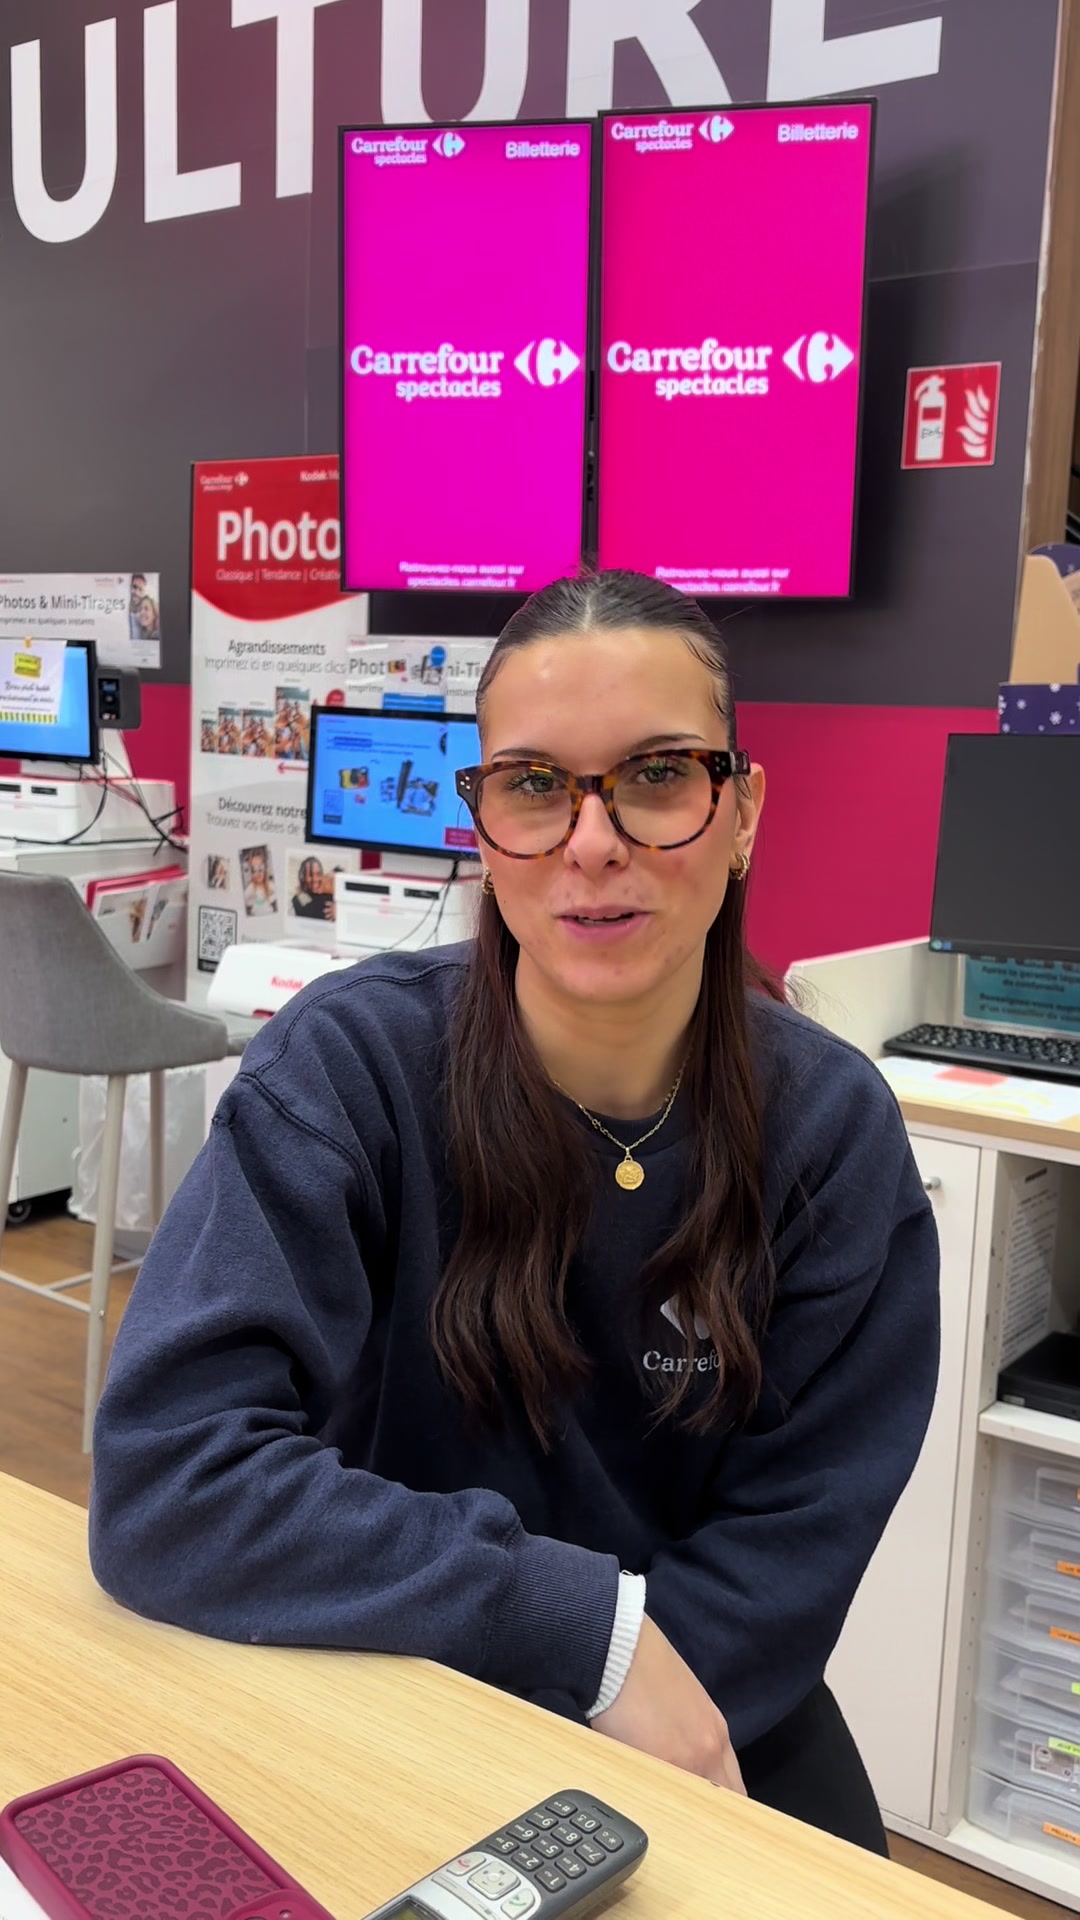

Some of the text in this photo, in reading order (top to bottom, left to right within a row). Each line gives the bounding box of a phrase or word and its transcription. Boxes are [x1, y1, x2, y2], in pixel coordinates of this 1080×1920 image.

[611, 120, 694, 140] Carrefour
[777, 122, 859, 143] Billetterie
[351, 136, 428, 154] Carrefour
[505, 140, 581, 159] Billetterie
[350, 341, 505, 376] Carrefour
[607, 336, 773, 373] Carrefour
[395, 375, 502, 403] spectacles
[655, 371, 769, 401] spectacles
[217, 506, 340, 562] Photo
[216, 568, 254, 583] Classique
[261, 568, 302, 581] Tendance
[51, 594, 126, 614] Mini-Tirages
[228, 640, 326, 657] Agrandissements
[204, 656, 248, 671] Imprimez
[278, 659, 321, 675] quelques
[218, 796, 273, 816] Découvrez
[206, 812, 240, 829] Trouvez
[243, 819, 257, 831] vos
[260, 820, 284, 834] idées
[541, 1816, 553, 1826] 9
[522, 1829, 534, 1838] 6
[565, 1832, 578, 1841] 8
[501, 1841, 514, 1850] 3
[545, 1844, 559, 1854] 5
[526, 1856, 539, 1867] 2
[588, 1852, 601, 1860] 7
[568, 1863, 580, 1872] 4
[549, 1877, 560, 1885] 1
